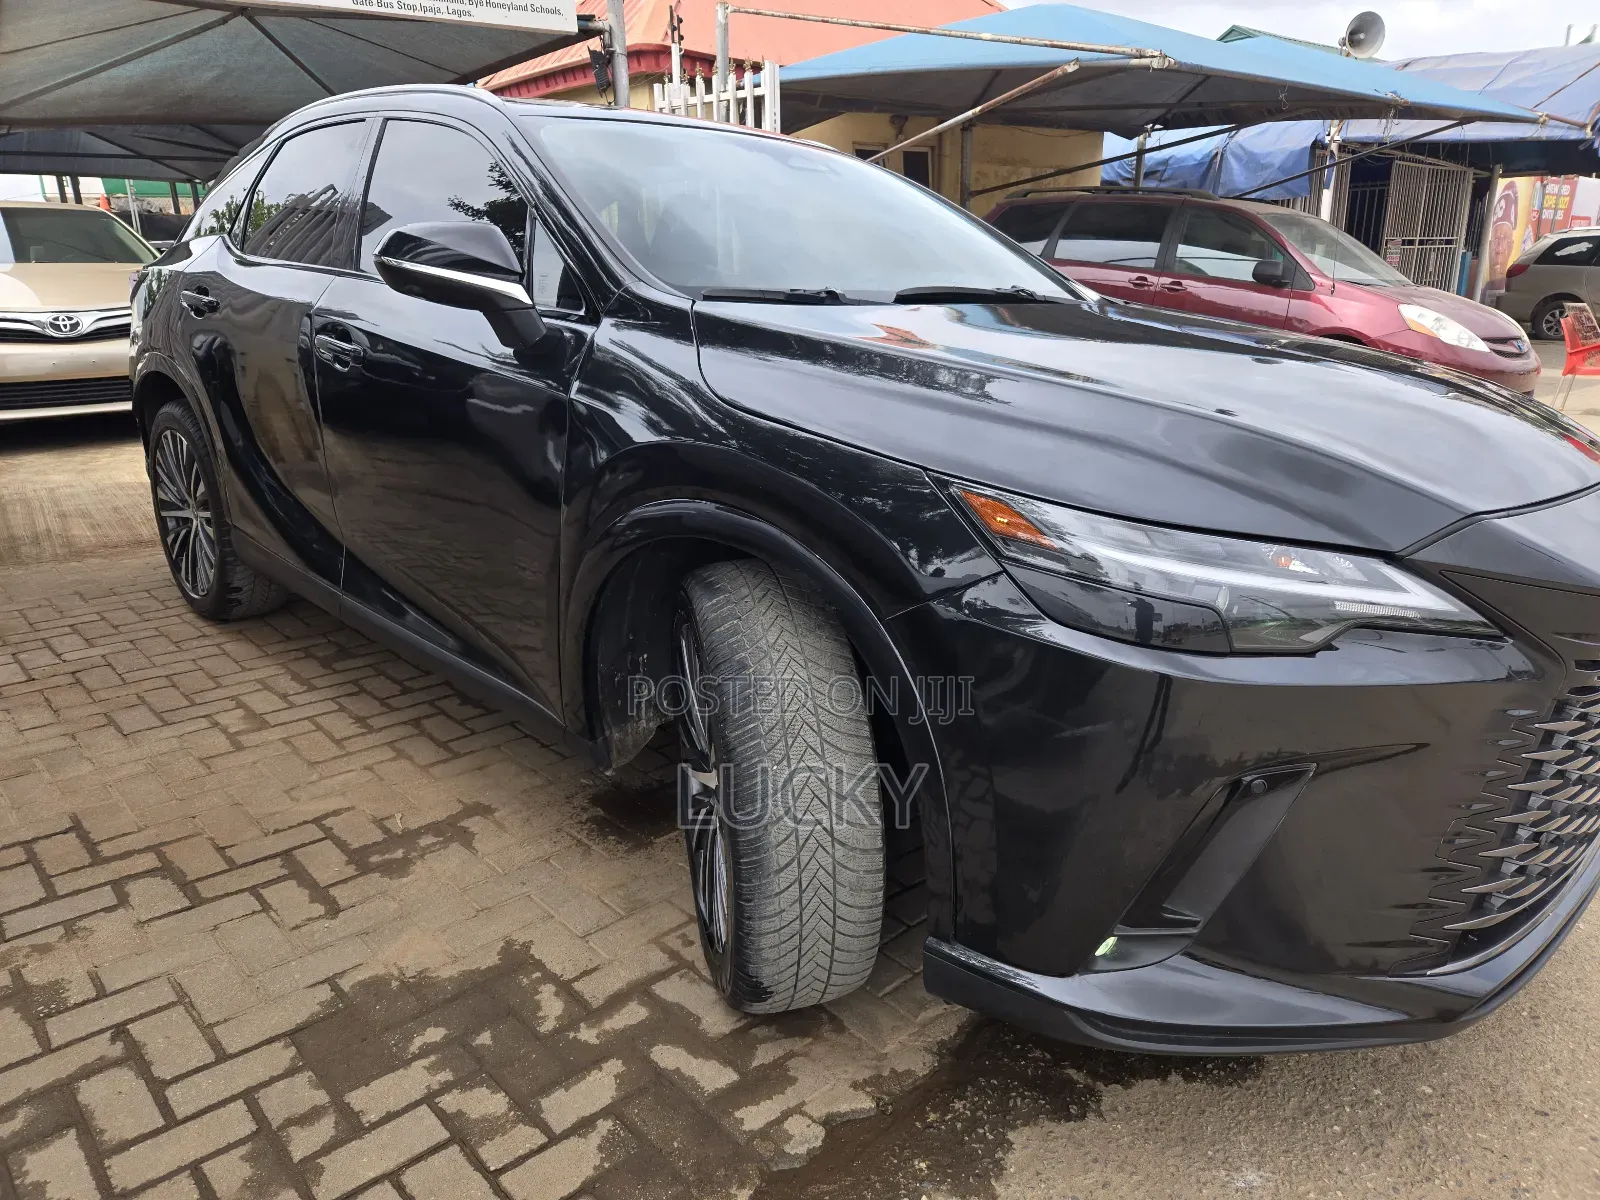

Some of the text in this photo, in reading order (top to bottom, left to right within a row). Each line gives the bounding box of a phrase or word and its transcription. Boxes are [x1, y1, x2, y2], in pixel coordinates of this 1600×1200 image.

[377, 0, 394, 9] Bus
[446, 6, 475, 18] Lagos.
[485, 0, 528, 12] Honeyland
[530, 4, 564, 16] Schools,
